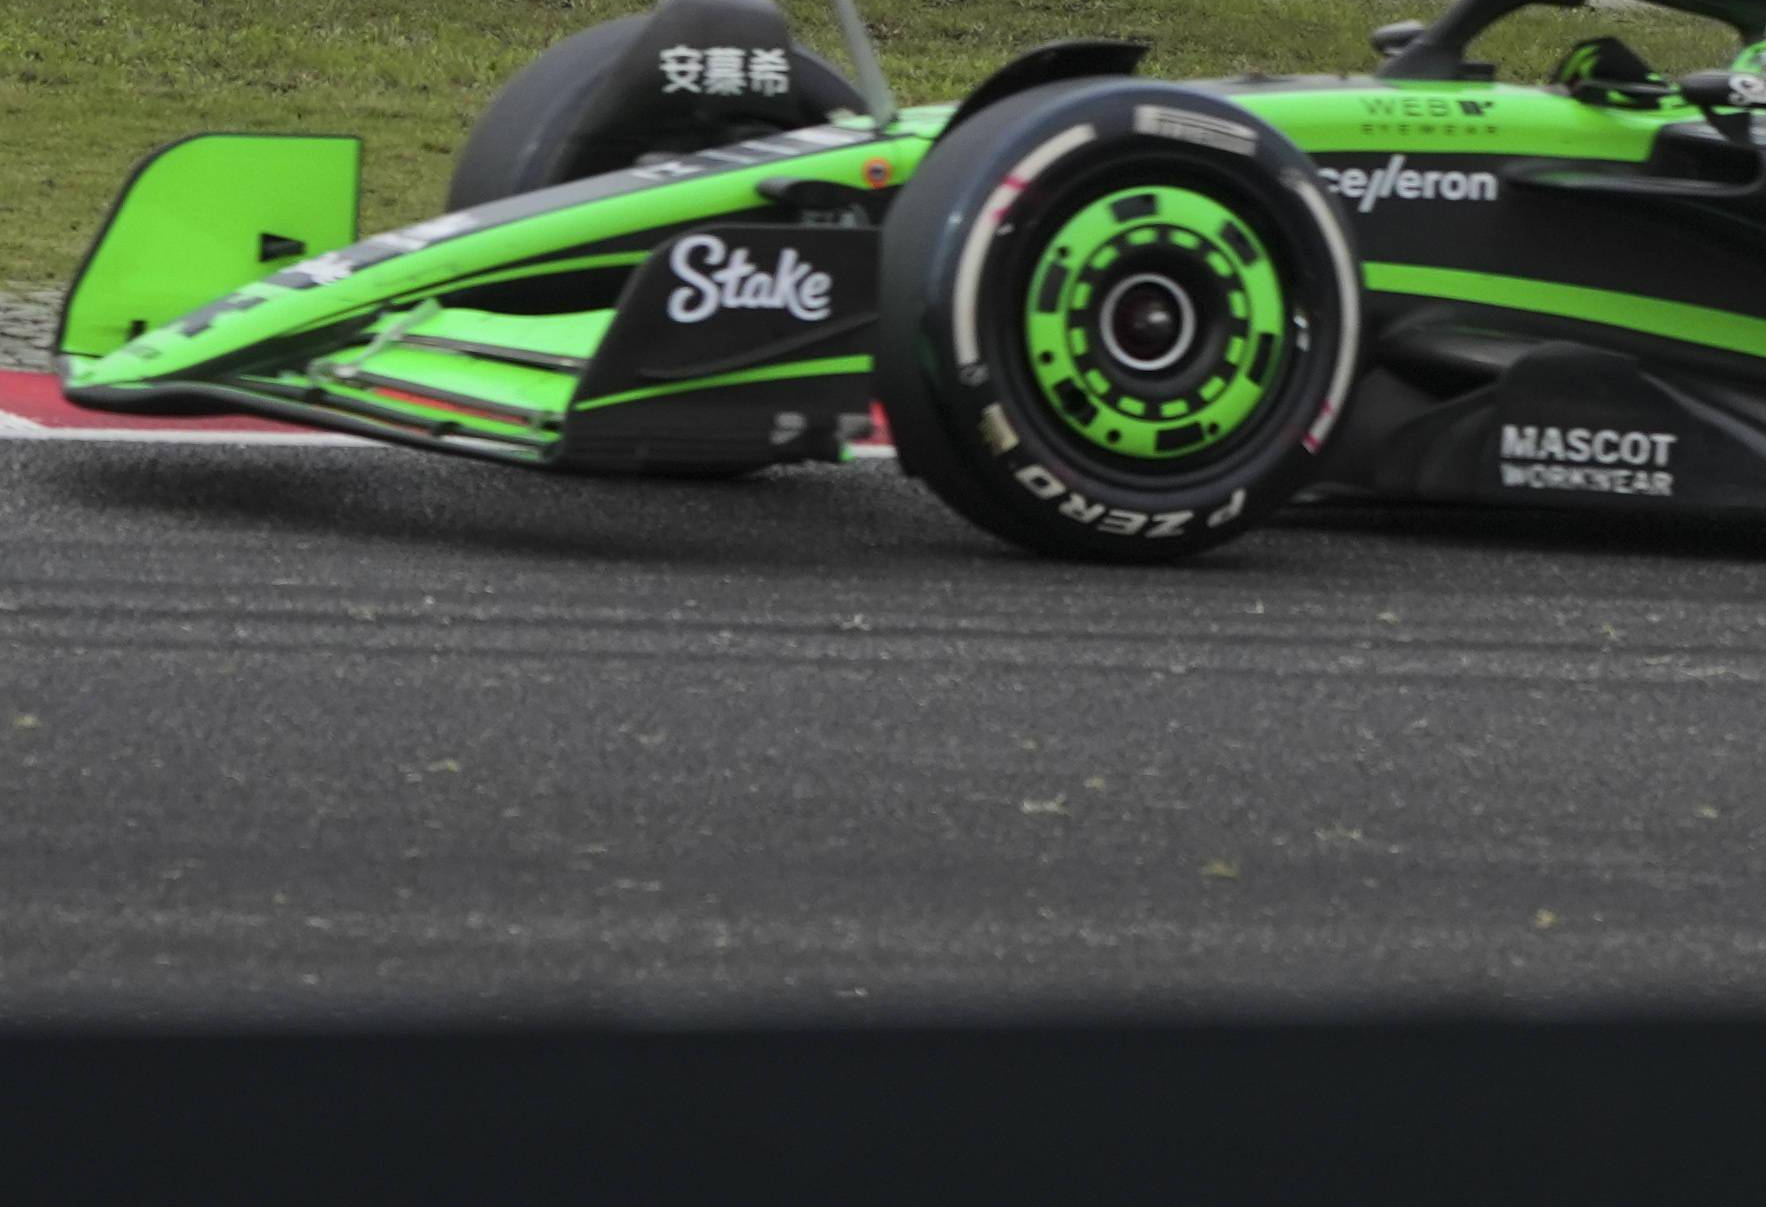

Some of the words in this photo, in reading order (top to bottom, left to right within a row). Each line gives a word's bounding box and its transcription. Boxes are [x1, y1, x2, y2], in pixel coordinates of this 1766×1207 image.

[658, 43, 792, 98] 安慕希
[1362, 97, 1450, 118] WEB
[664, 234, 834, 323] Stake
[1501, 424, 1680, 467] MASCOT
[1013, 461, 1197, 538] ZERO
